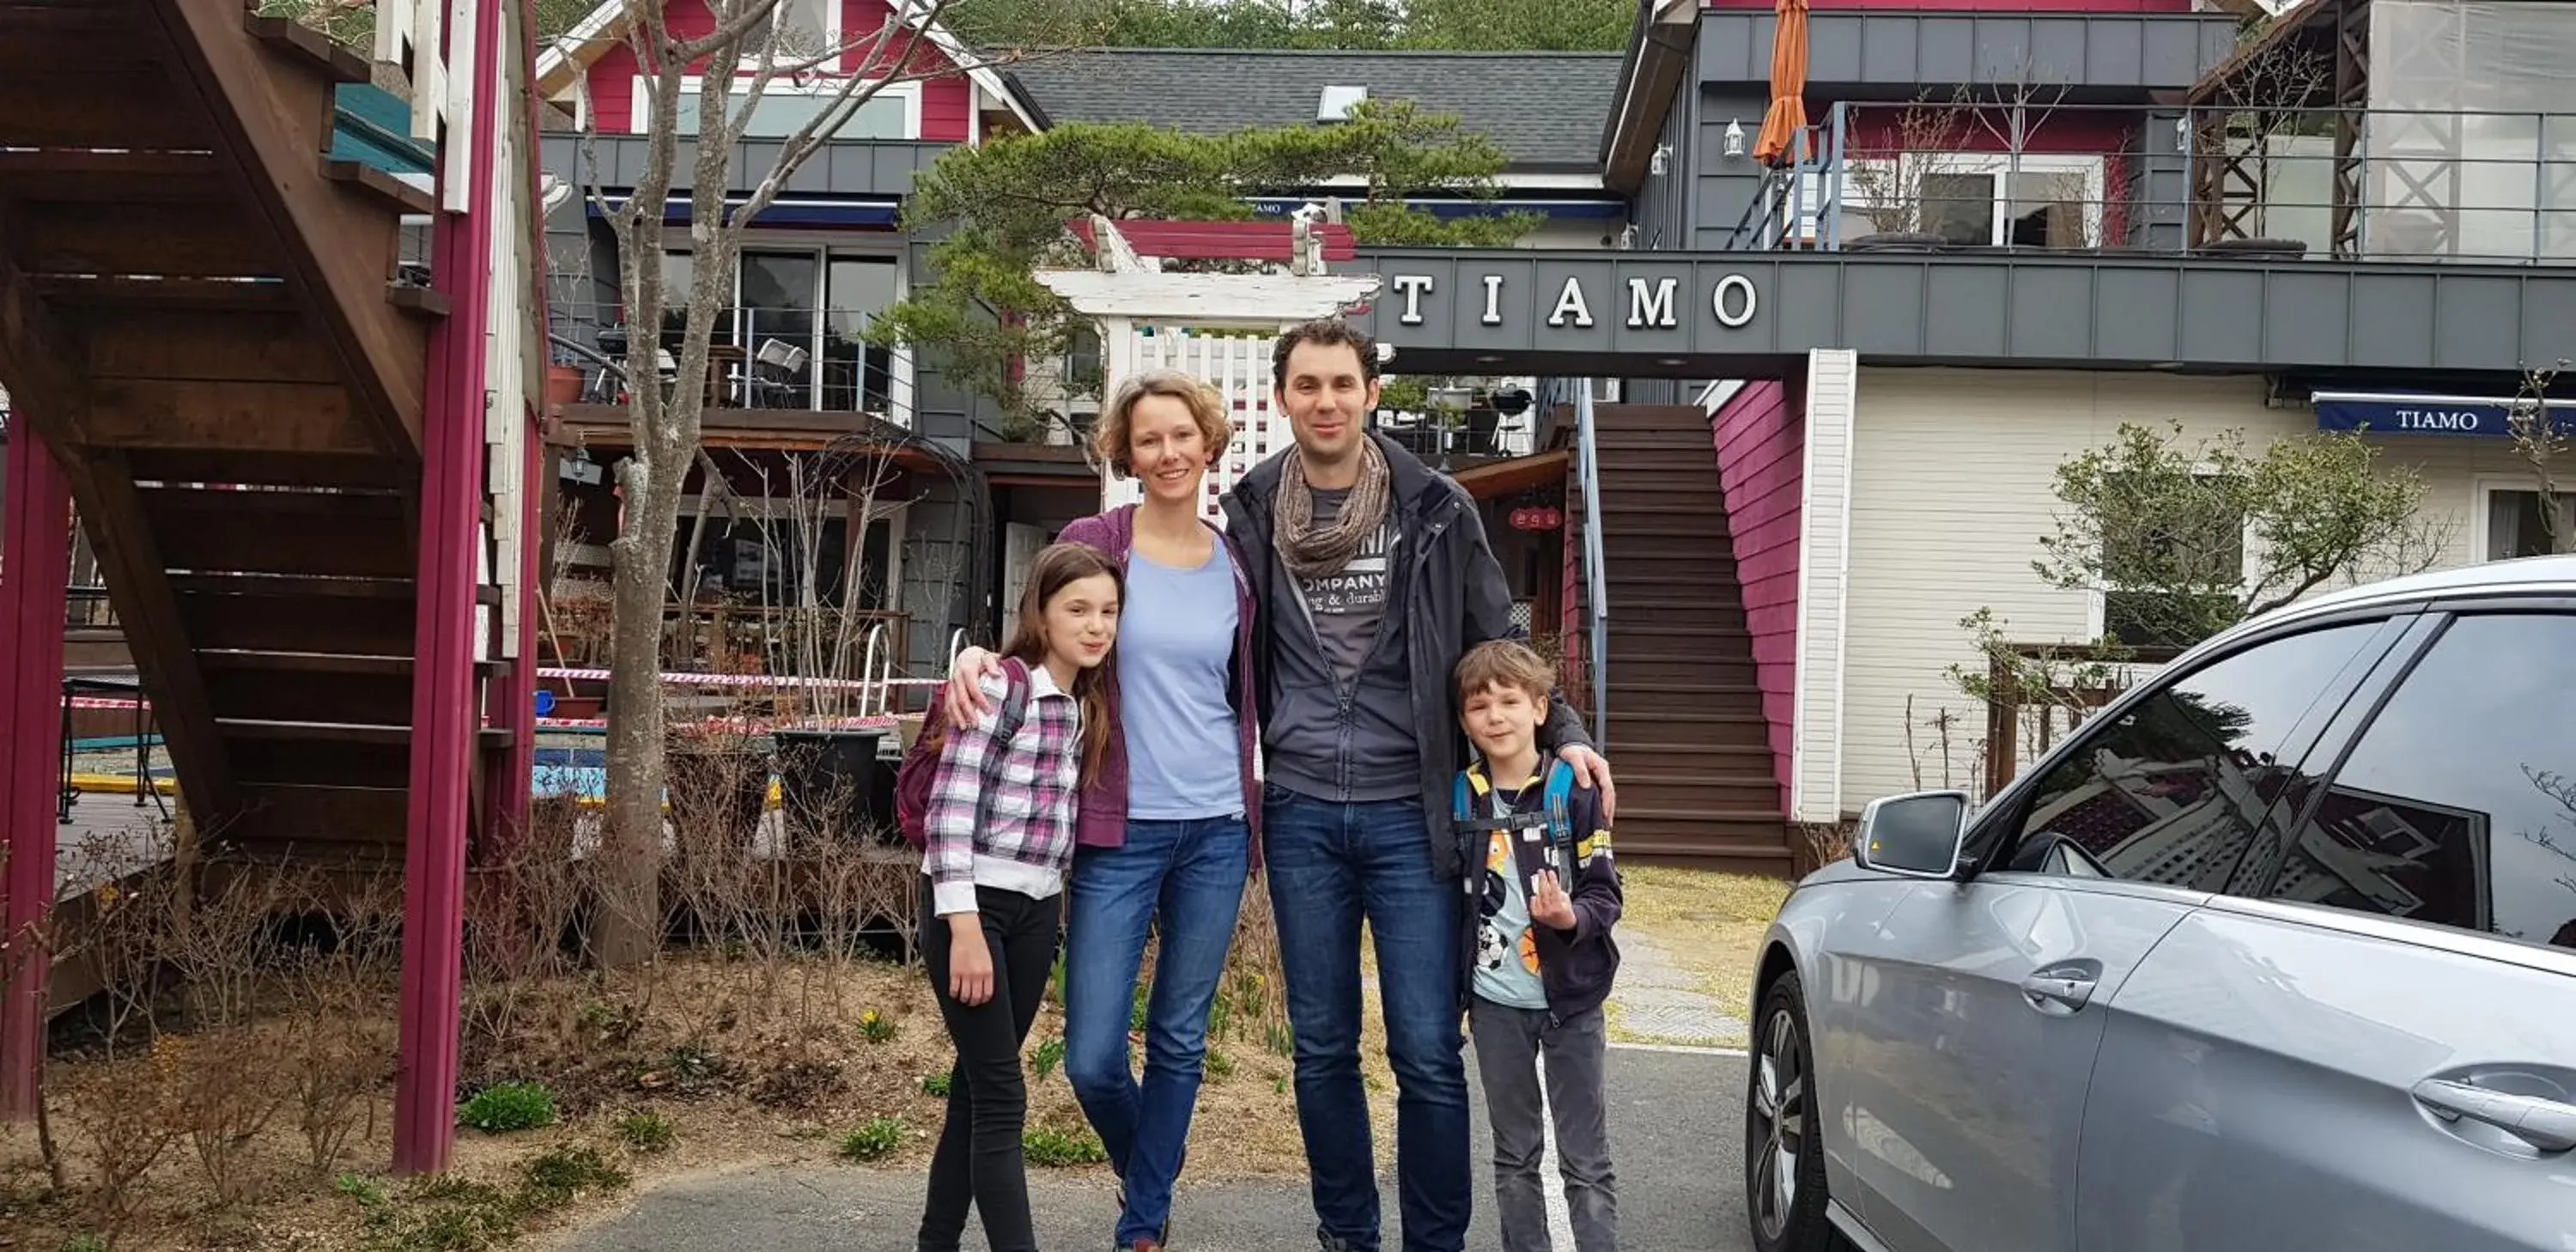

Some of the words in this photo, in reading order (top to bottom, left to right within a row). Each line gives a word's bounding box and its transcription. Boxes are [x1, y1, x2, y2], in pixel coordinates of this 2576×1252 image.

[1254, 203, 1280, 214] AMO
[1394, 274, 1758, 326] TIAMO
[2396, 410, 2478, 430] TIAMO
[1304, 574, 1385, 593] OMPANY
